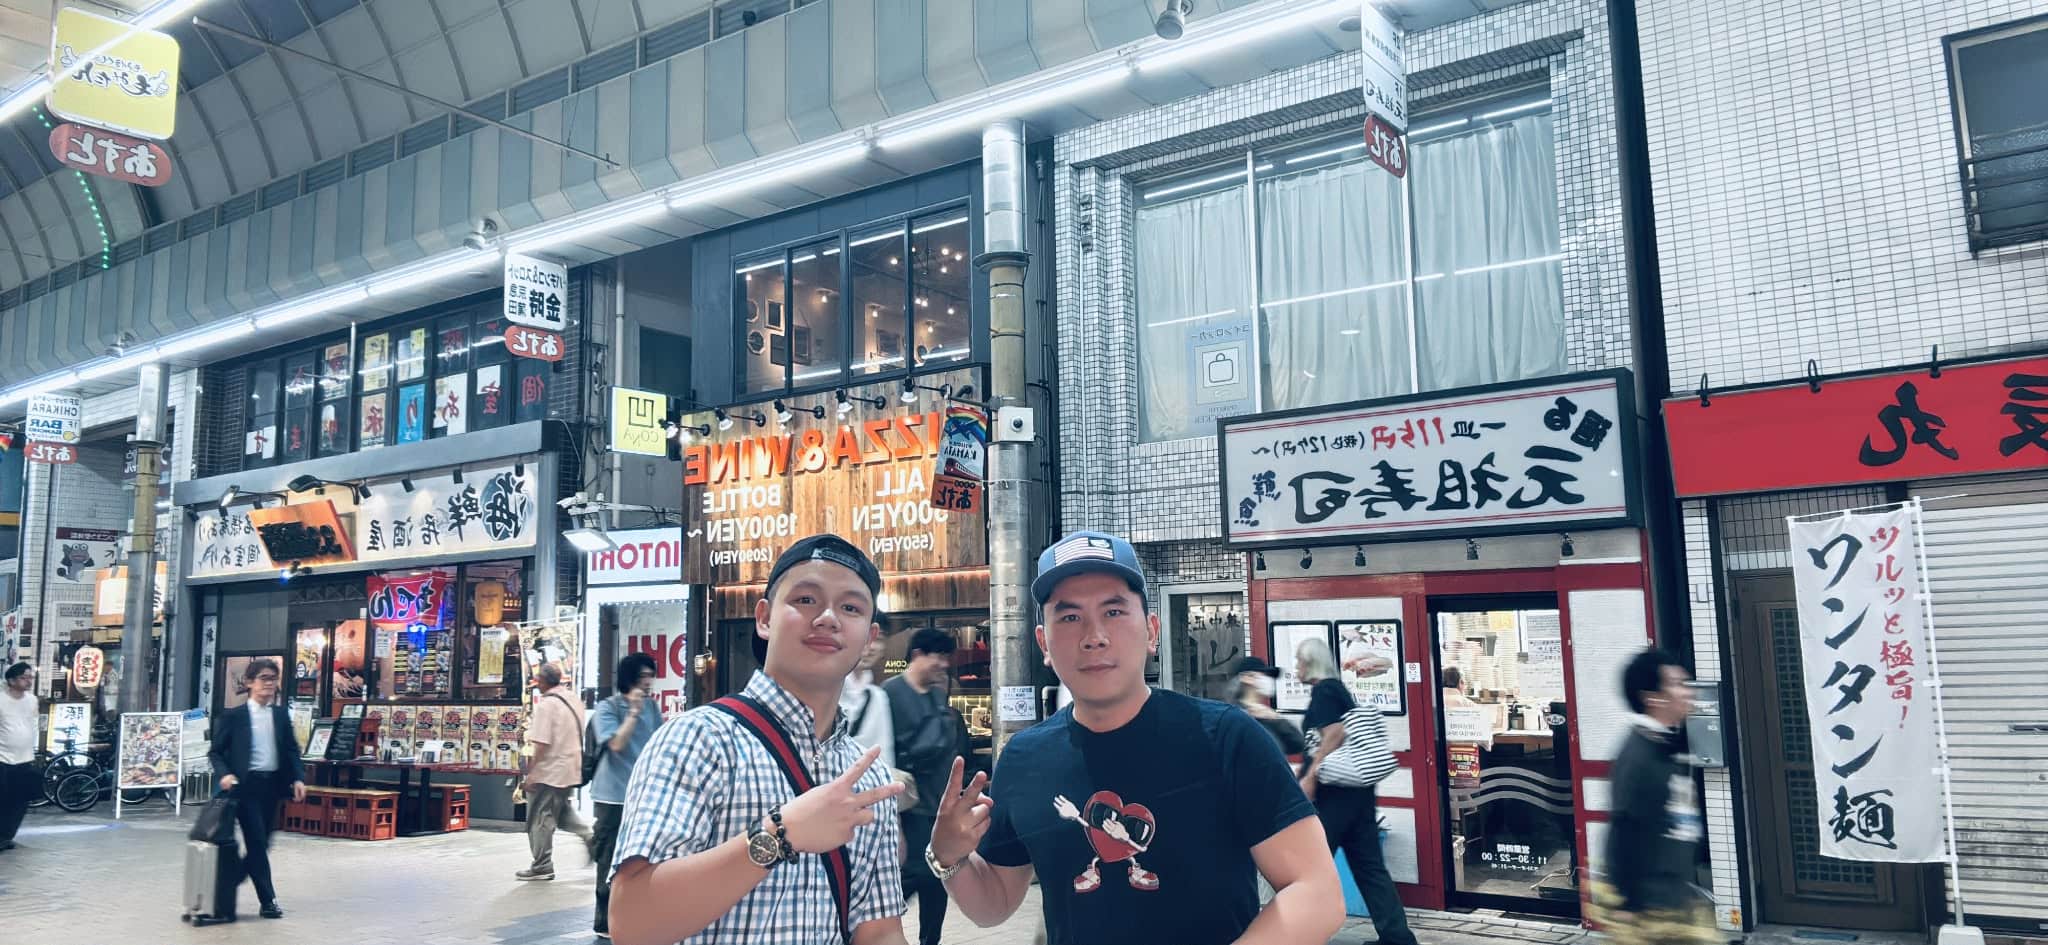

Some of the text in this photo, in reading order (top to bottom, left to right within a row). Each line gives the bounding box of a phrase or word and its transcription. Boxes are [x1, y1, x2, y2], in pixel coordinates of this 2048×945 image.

[1807, 533, 1897, 850] ワンタン麺
